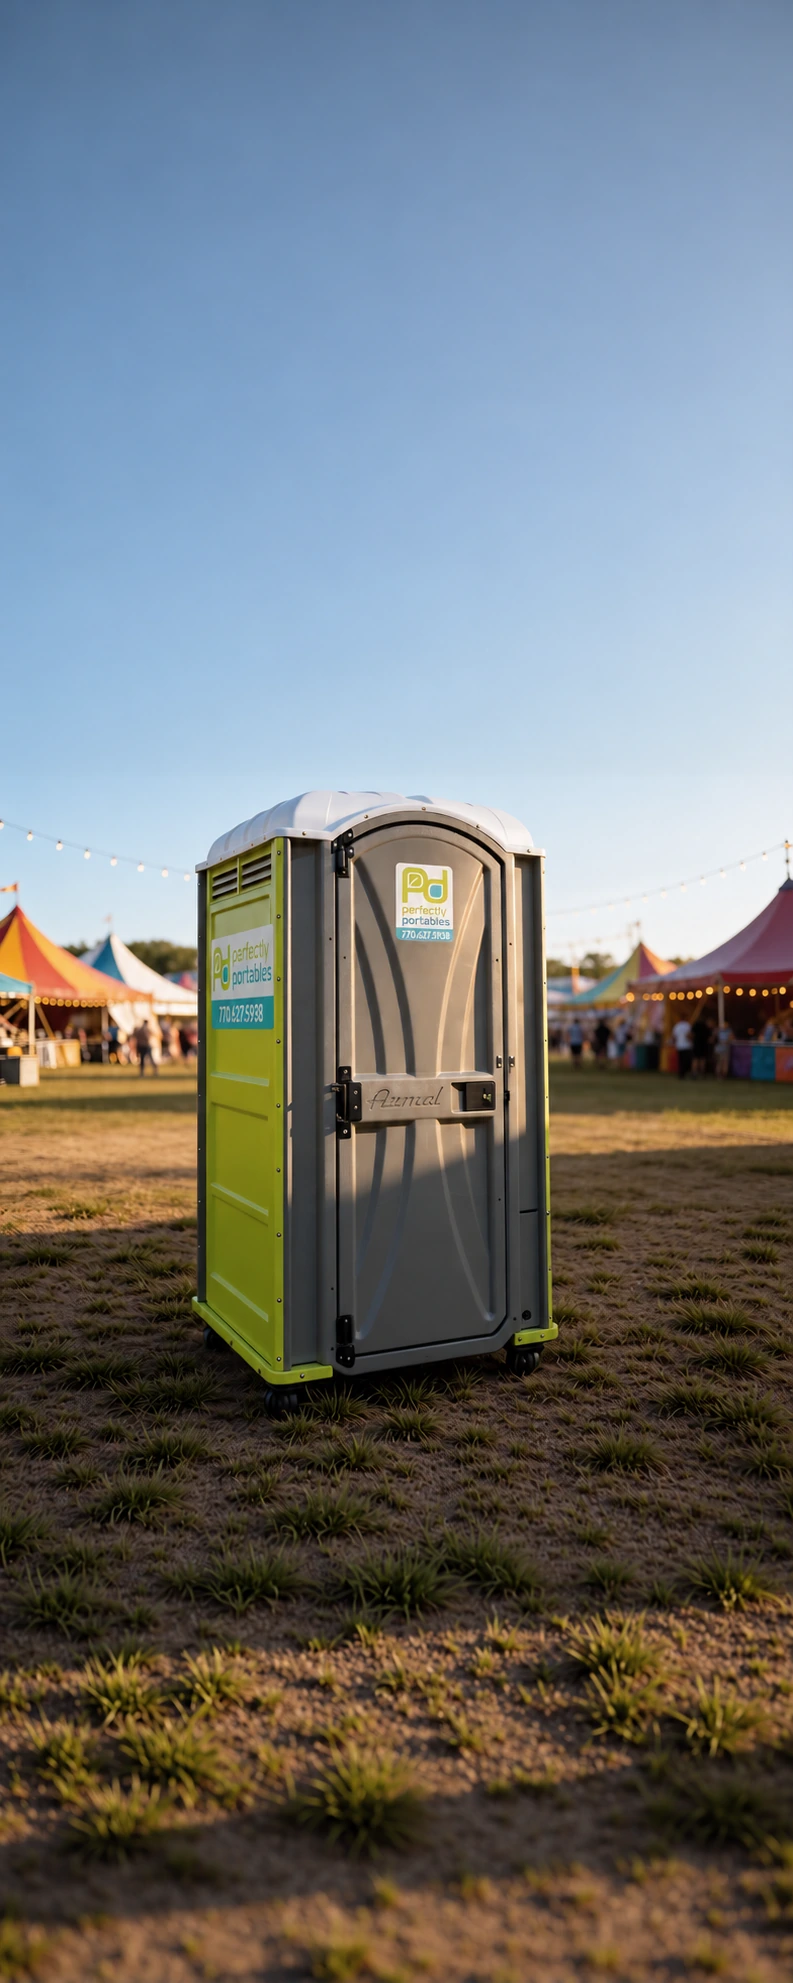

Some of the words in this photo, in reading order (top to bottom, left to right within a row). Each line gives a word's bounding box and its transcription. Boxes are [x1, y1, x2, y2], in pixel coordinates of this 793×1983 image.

[402, 906, 447, 917] perfectly
[402, 916, 450, 926] portables
[233, 939, 269, 966] perfectly
[232, 963, 272, 990] portables
